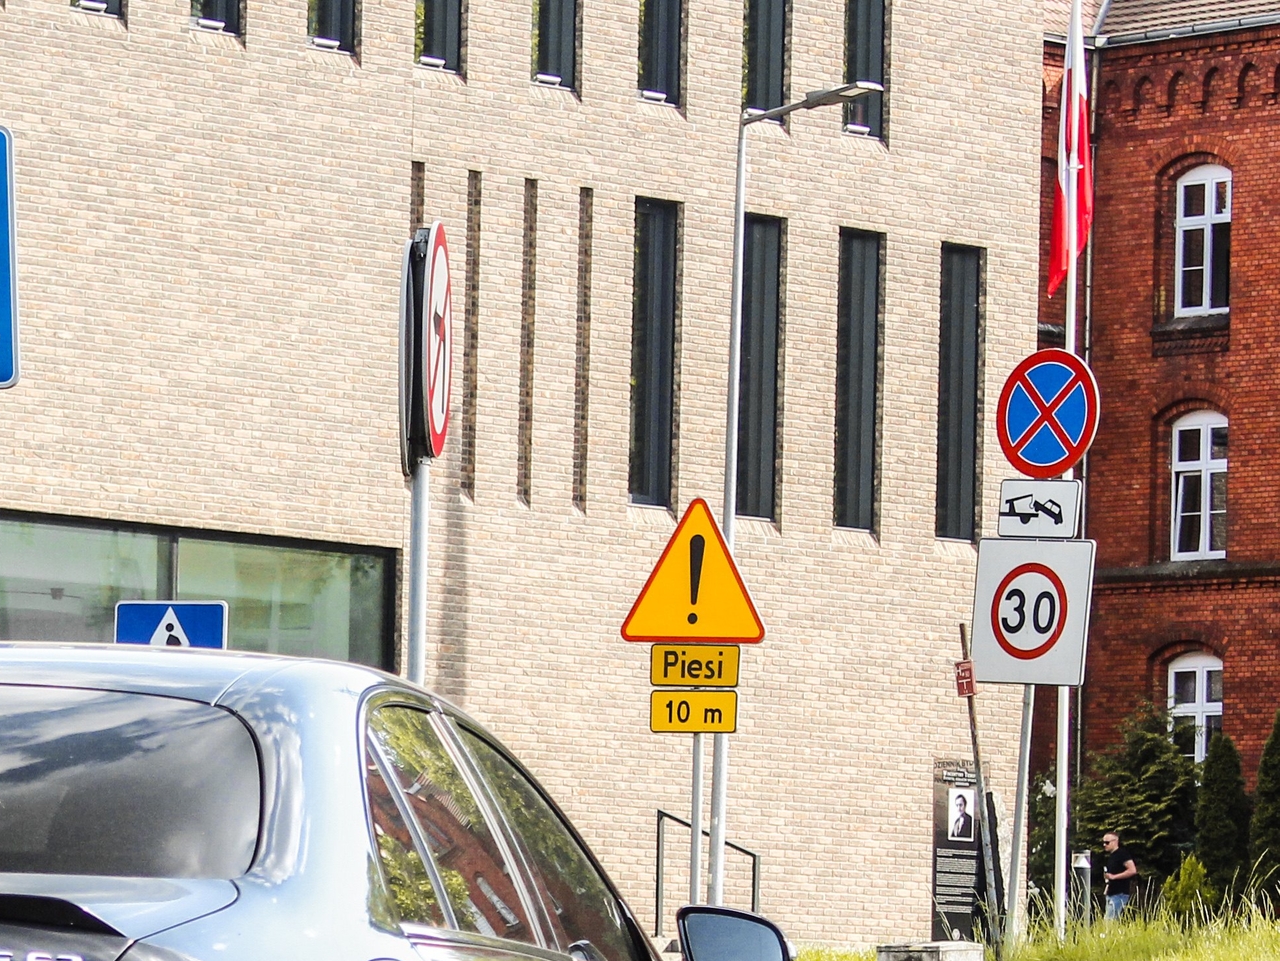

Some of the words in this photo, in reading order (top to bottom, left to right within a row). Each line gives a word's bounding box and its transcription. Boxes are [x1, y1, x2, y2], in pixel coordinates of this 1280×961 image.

[1001, 588, 1056, 635] 30
[663, 650, 724, 680] Piesi
[665, 700, 691, 724] 10
[703, 708, 723, 724] m
